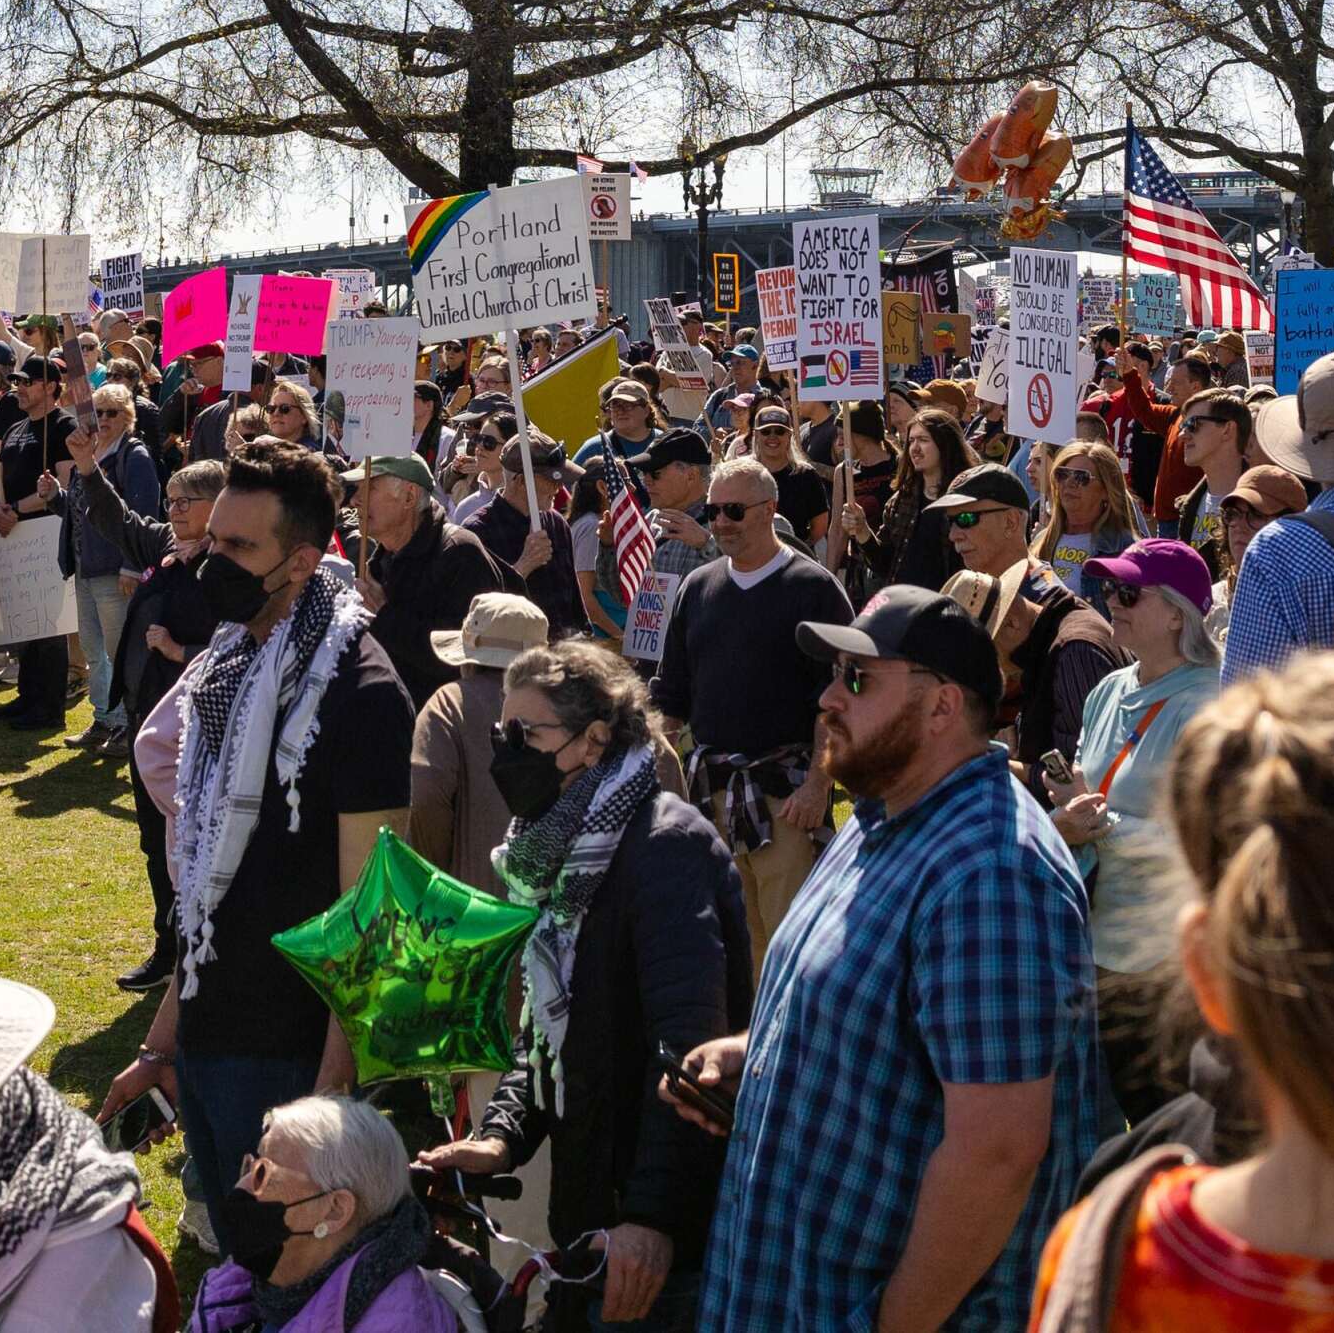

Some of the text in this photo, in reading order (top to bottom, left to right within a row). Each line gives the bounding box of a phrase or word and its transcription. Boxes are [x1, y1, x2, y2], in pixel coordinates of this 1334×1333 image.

[457, 203, 562, 250] Portland
[801, 227, 871, 252] AMERICA
[105, 254, 138, 276] FIGHT
[427, 235, 581, 291] First Congregational
[799, 250, 868, 271] DOES NOT
[1014, 254, 1071, 289] NO HUMAN
[102, 272, 142, 293] TRUMP'S
[798, 274, 871, 297] WANT TO
[1145, 285, 1173, 299] NOT
[1280, 276, 1301, 296] I
[1303, 281, 1321, 292] will
[103, 291, 143, 312] AGENDA
[417, 272, 592, 330] United Church of Christ
[759, 292, 784, 318] THE
[801, 298, 879, 319] FIGHT FOR
[1017, 291, 1065, 315] SHOULD BE
[1281, 308, 1290, 318] a
[1296, 301, 1319, 318] fully
[1018, 312, 1072, 338] CONSIDERED
[1147, 308, 1173, 321] IT IS
[236, 334, 251, 342] TRUMP
[396, 331, 413, 352] day
[810, 322, 876, 348] ISRAEL
[775, 345, 786, 354] OUT
[1015, 336, 1072, 375] ILLEGAL
[1280, 348, 1292, 361] to
[349, 362, 409, 383] reckoning is
[345, 390, 402, 416] approaching
[641, 576, 656, 592] NO
[636, 591, 666, 612] KINGS
[634, 609, 664, 631] SINCE
[632, 628, 659, 653] 1776
